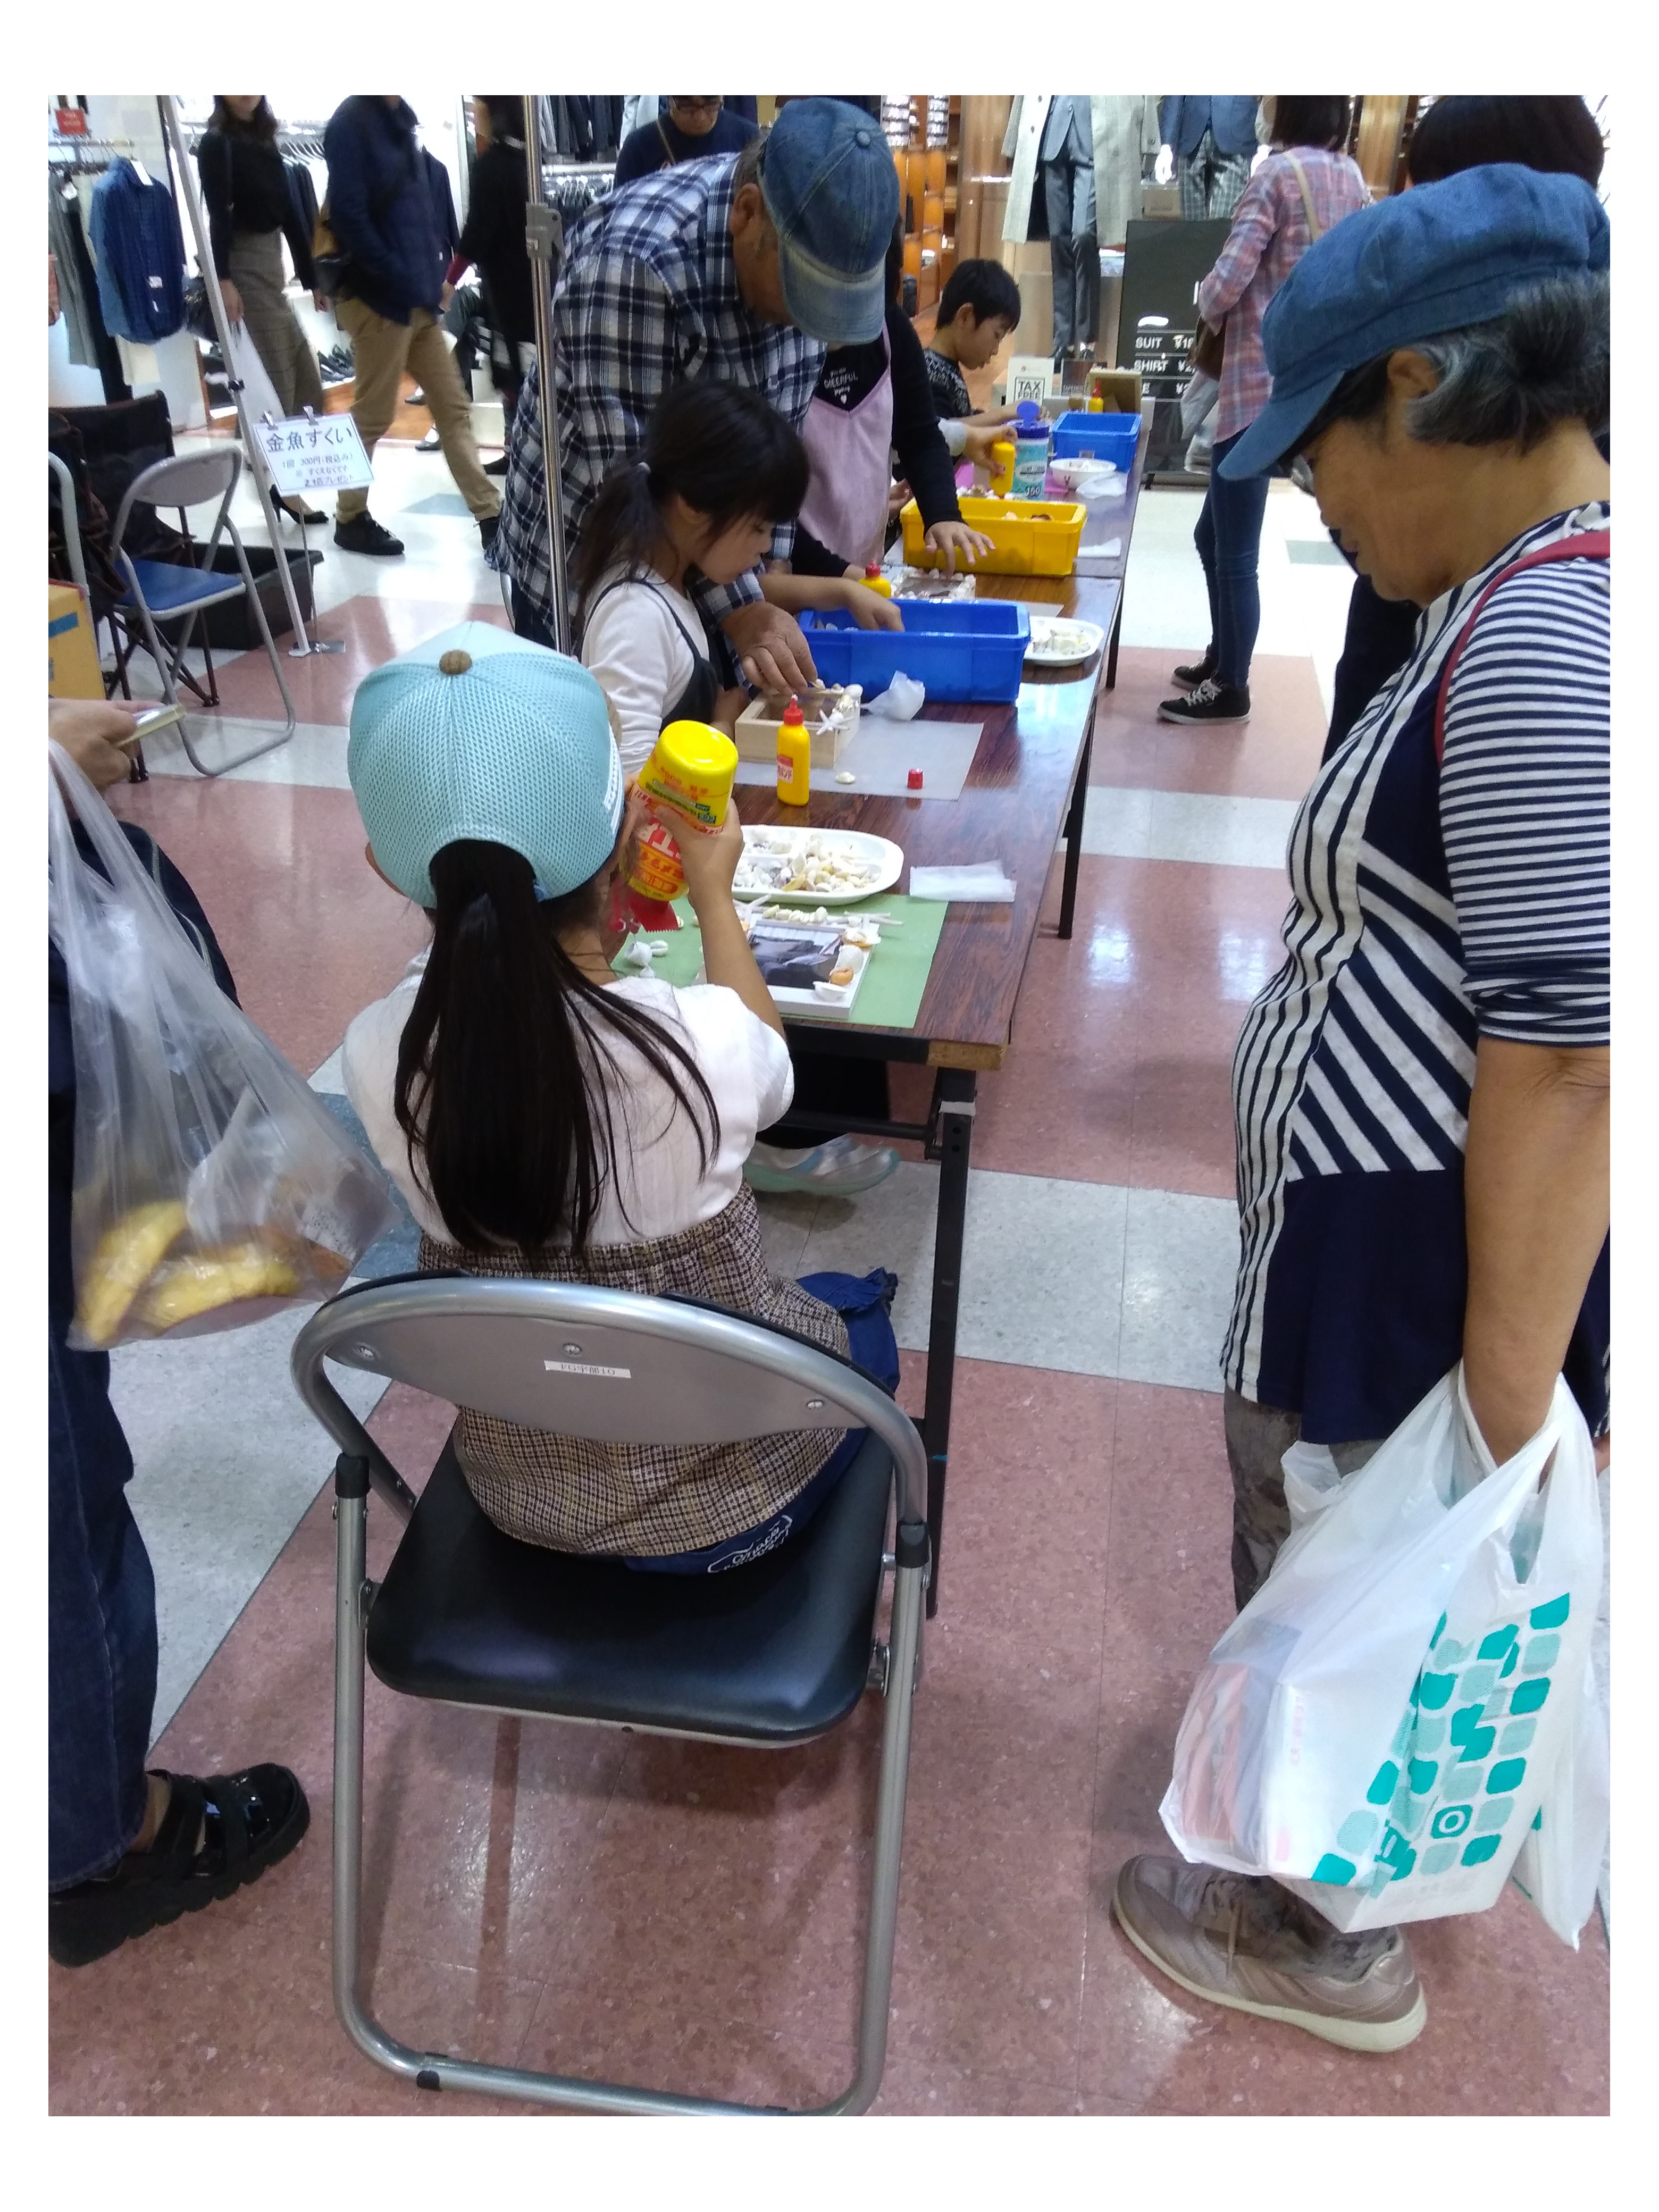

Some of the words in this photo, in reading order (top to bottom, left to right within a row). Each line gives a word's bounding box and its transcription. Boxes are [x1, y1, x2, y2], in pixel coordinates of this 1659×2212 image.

[1135, 337, 1163, 349] SUIT
[1133, 359, 1169, 373] SHIRT
[1018, 379, 1041, 392] TAX
[265, 427, 353, 453] 金魚すくい
